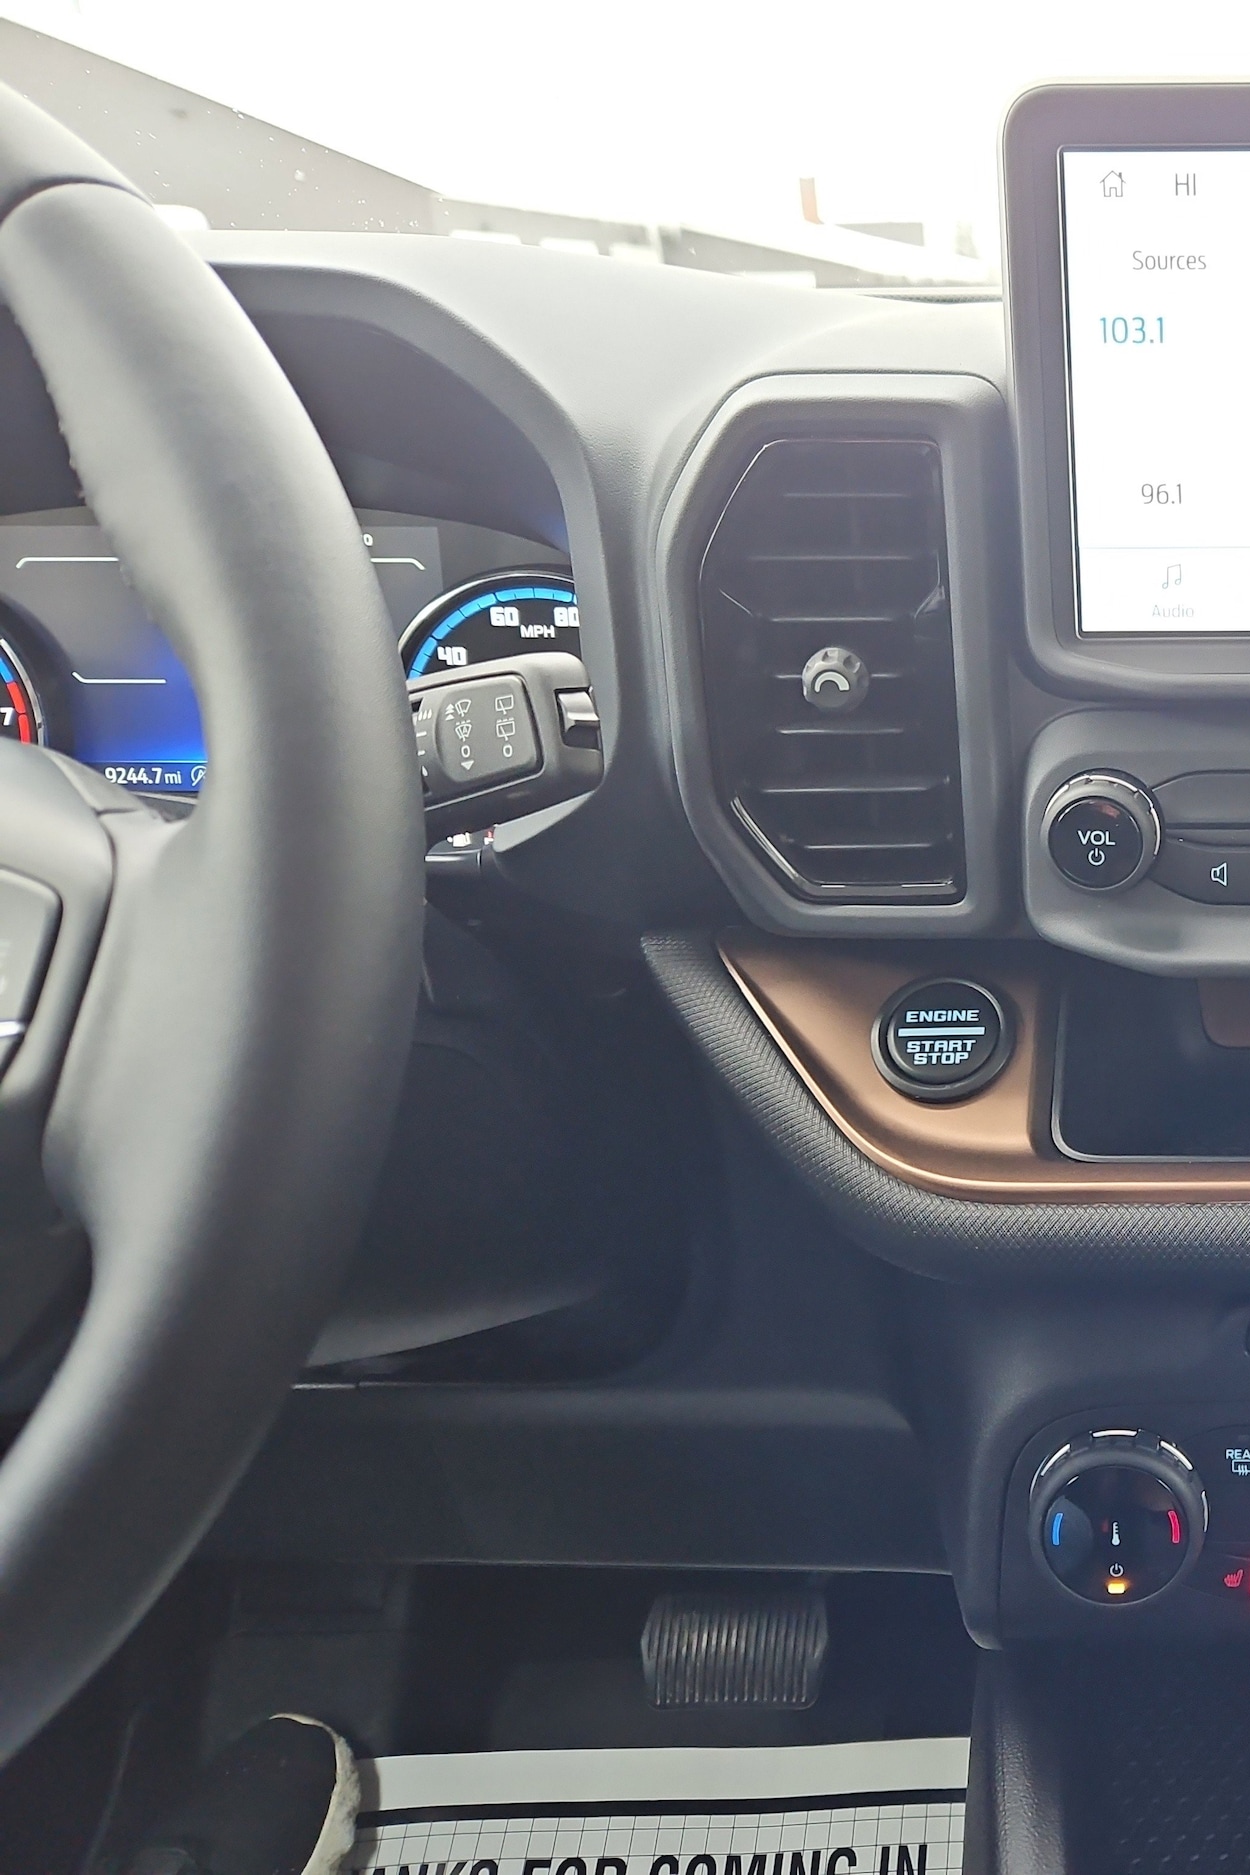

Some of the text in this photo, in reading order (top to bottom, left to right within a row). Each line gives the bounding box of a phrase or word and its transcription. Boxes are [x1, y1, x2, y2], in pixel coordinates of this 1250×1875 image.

[1174, 172, 1198, 197] HI
[1132, 250, 1207, 271] Sources
[1099, 316, 1166, 344] 103.1
[1140, 483, 1183, 505] 96.1
[489, 606, 580, 627] 60 80
[1151, 604, 1195, 619] Audio
[520, 625, 556, 639] MPH
[437, 646, 468, 666] 40
[0, 706, 14, 726] 7
[105, 767, 182, 785] 9244.7 mi
[1077, 830, 1116, 847] VOL
[905, 1009, 980, 1023] ENGINE
[906, 1039, 977, 1053] START
[913, 1052, 969, 1066] STOP
